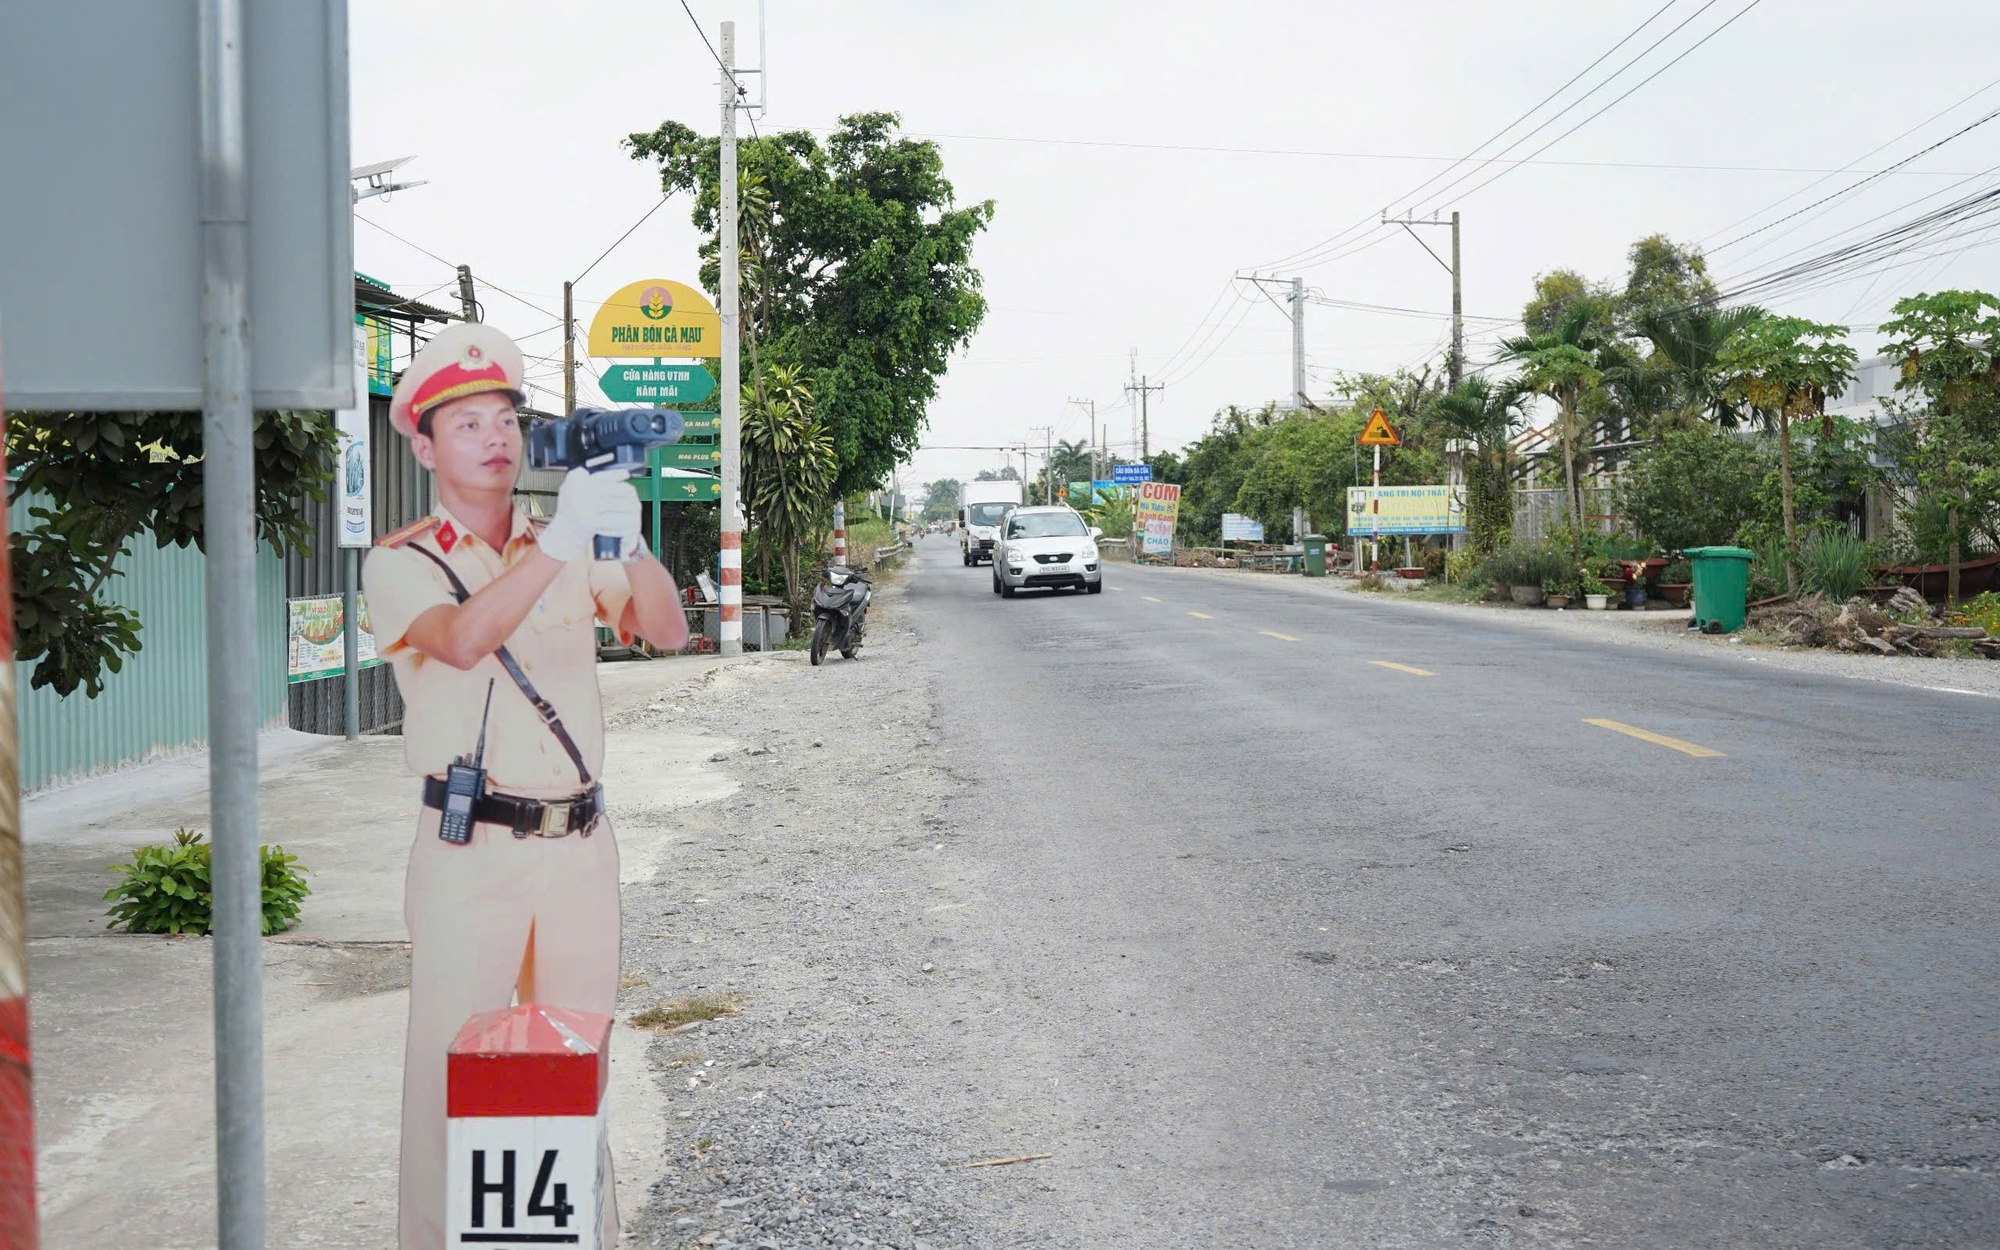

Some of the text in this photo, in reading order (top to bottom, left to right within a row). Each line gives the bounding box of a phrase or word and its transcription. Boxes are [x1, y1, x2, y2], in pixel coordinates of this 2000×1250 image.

[612, 325, 701, 343] PHÂN BÓN CÀ MAU
[643, 369, 666, 381] HÀNG
[636, 385, 657, 397] NĂM
[1143, 483, 1178, 501] CƠM
[471, 1149, 574, 1228] H4
